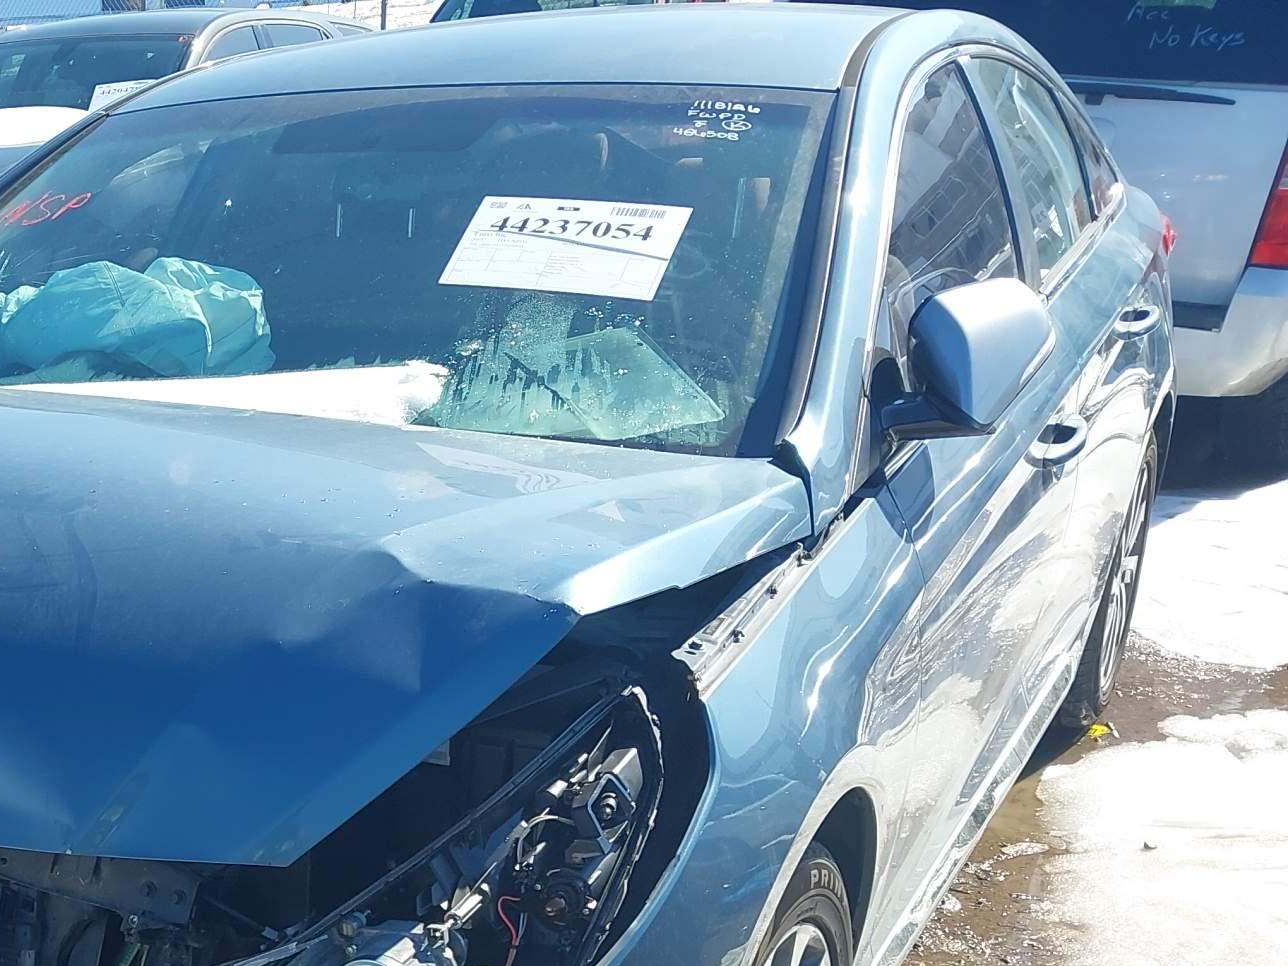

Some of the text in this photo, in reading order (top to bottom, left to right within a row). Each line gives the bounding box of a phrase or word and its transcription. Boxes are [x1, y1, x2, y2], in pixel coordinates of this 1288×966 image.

[1149, 24, 1245, 51] No Keys
[490, 215, 654, 241] 44237054
